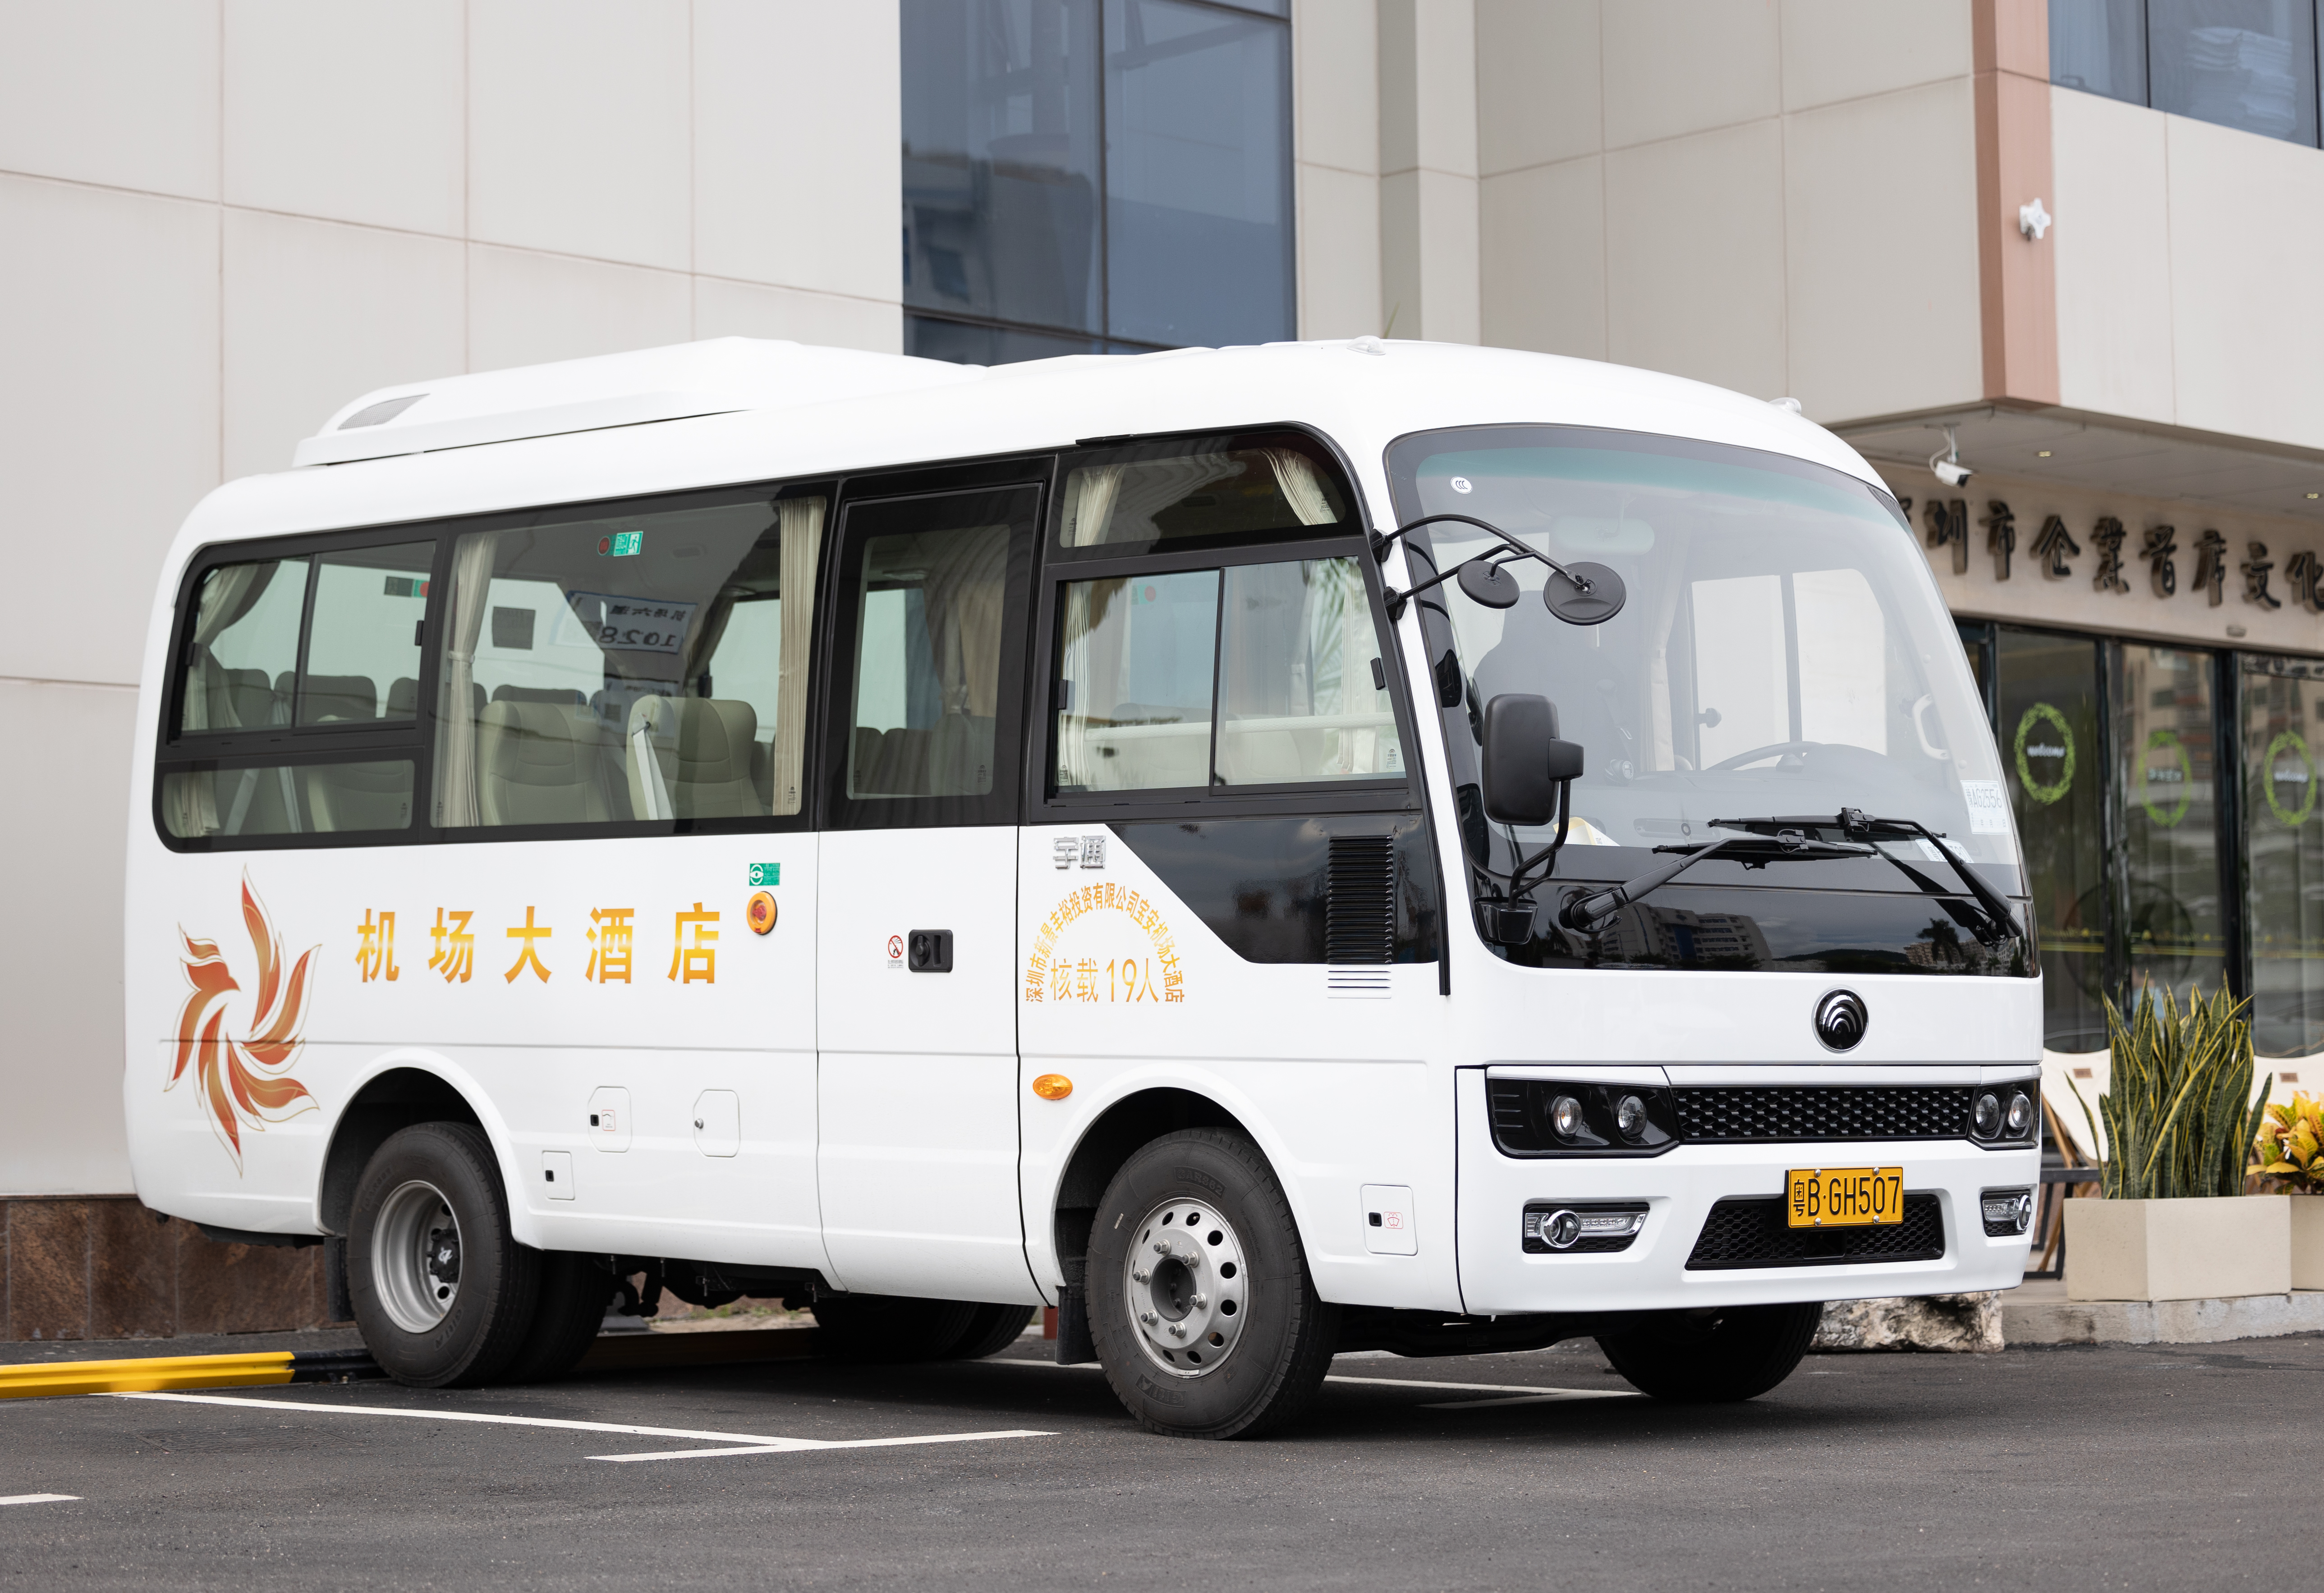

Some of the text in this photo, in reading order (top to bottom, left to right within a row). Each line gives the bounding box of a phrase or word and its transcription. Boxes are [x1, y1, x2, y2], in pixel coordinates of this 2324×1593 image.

[355, 902, 720, 984] 机场大酒店
[1050, 958, 1159, 1003] 核载19人
